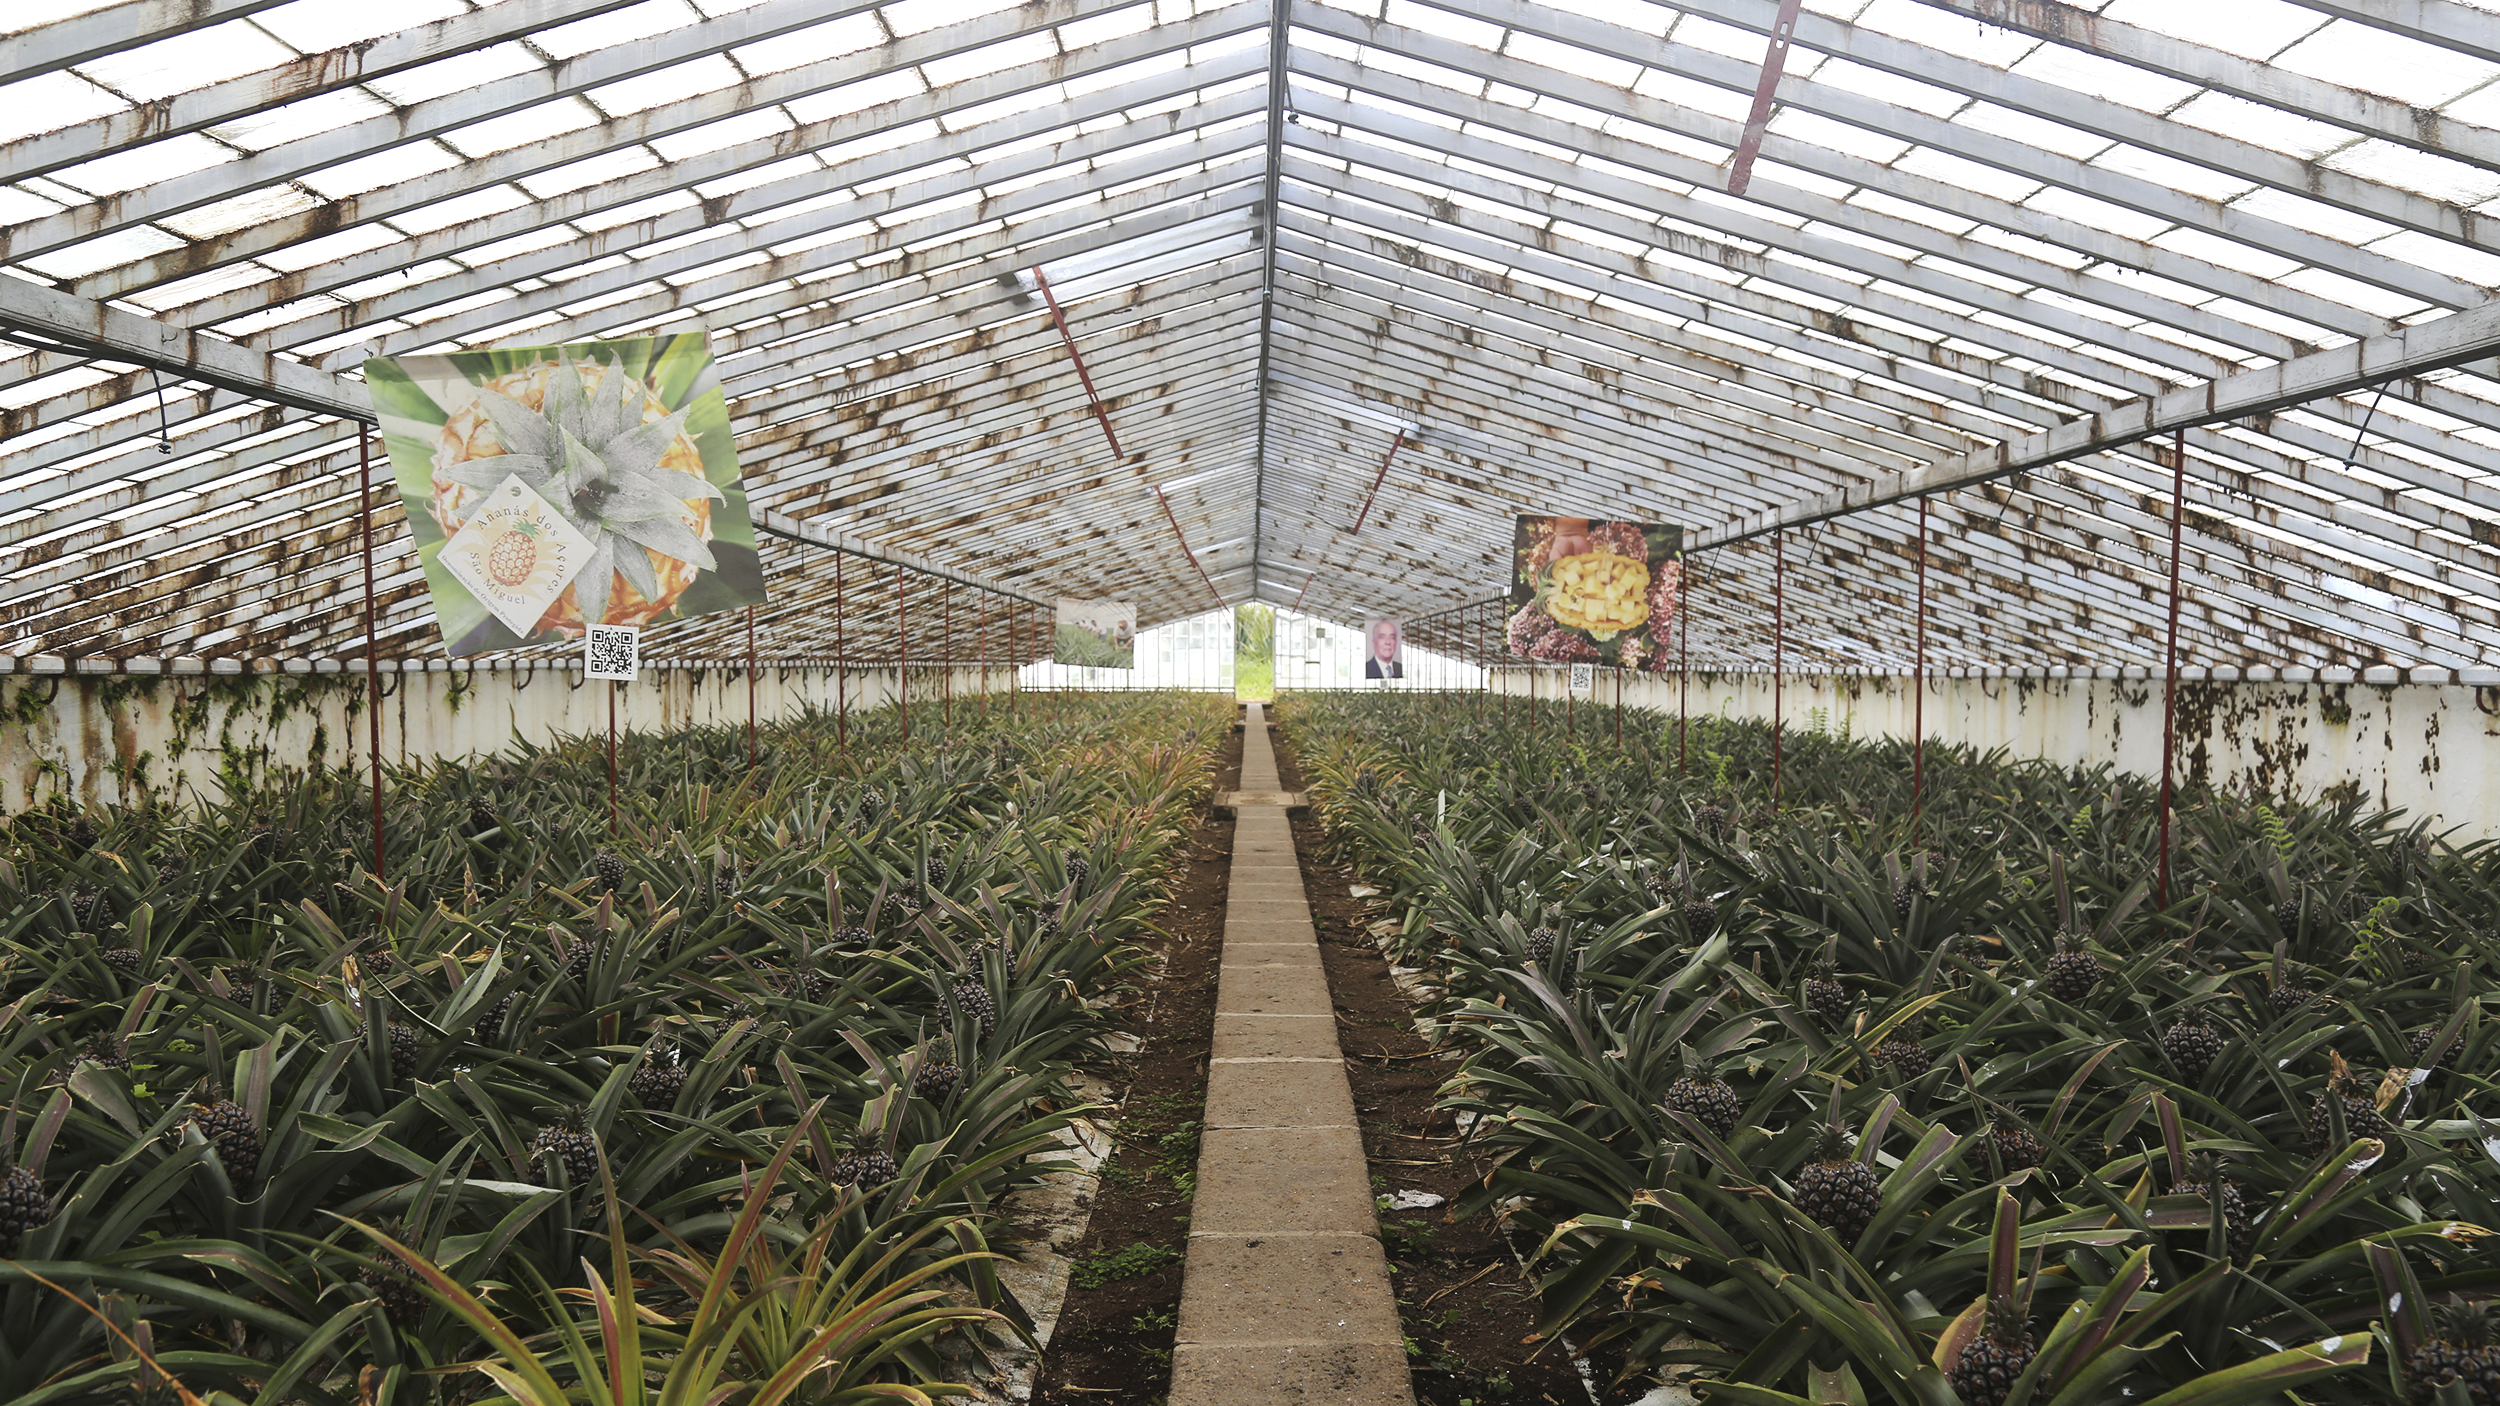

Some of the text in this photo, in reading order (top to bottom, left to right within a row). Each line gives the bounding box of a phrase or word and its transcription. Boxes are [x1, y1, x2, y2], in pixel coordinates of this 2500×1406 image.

[470, 552, 525, 605] São Miguel
[476, 505, 566, 594] Ananás dos Açores
